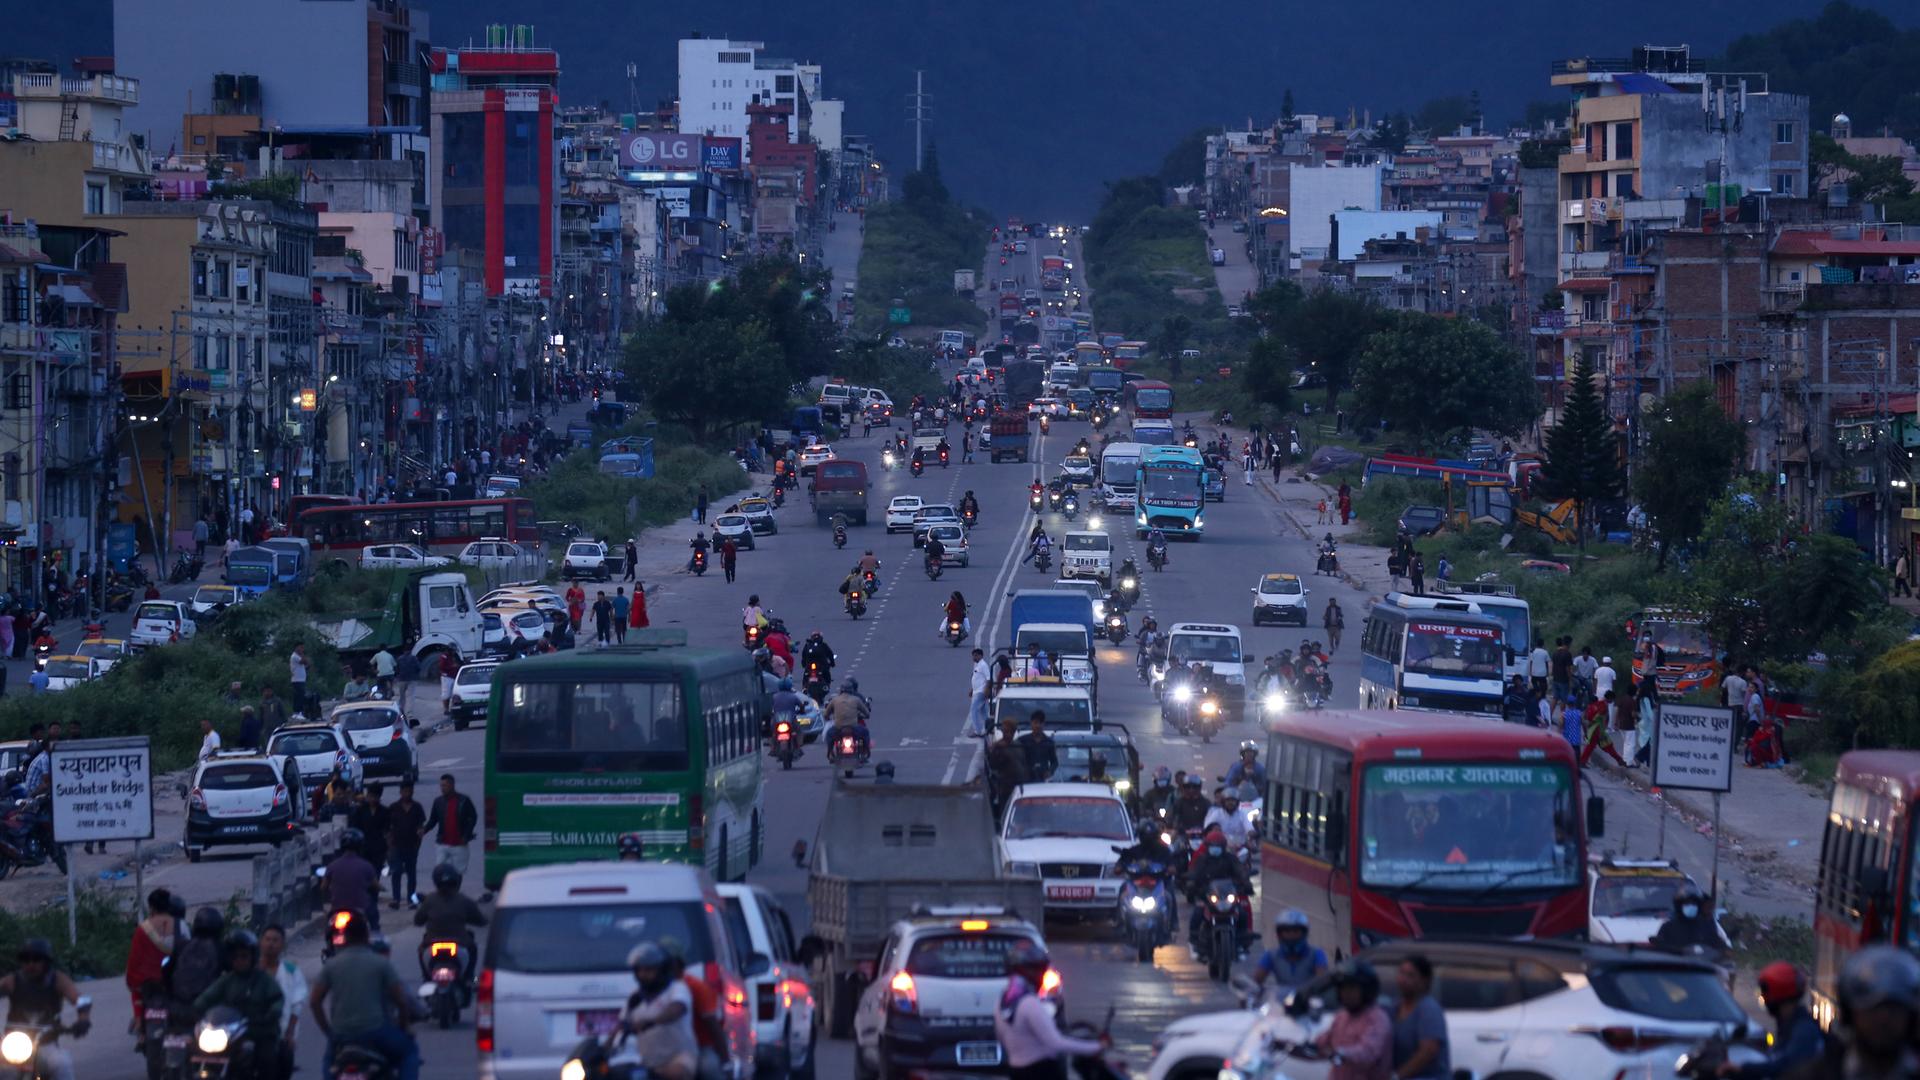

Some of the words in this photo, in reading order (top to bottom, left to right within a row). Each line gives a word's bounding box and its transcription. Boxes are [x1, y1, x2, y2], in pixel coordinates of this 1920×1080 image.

[660, 141, 688, 159] LG
[711, 147, 729, 156] DAV
[1664, 732, 1699, 741] Suichatar
[1702, 735, 1726, 744] Bridge
[60, 755, 116, 779] स्युचाटार
[544, 777, 585, 787] ASHOK
[587, 777, 642, 786] LEYLAND
[1383, 766, 1457, 784] महानगर
[1462, 767, 1533, 783] यातायात
[56, 781, 109, 797] Suichatar
[111, 780, 144, 797] Bridge
[553, 832, 585, 845] SAJHA
[587, 832, 618, 845] YATAY
